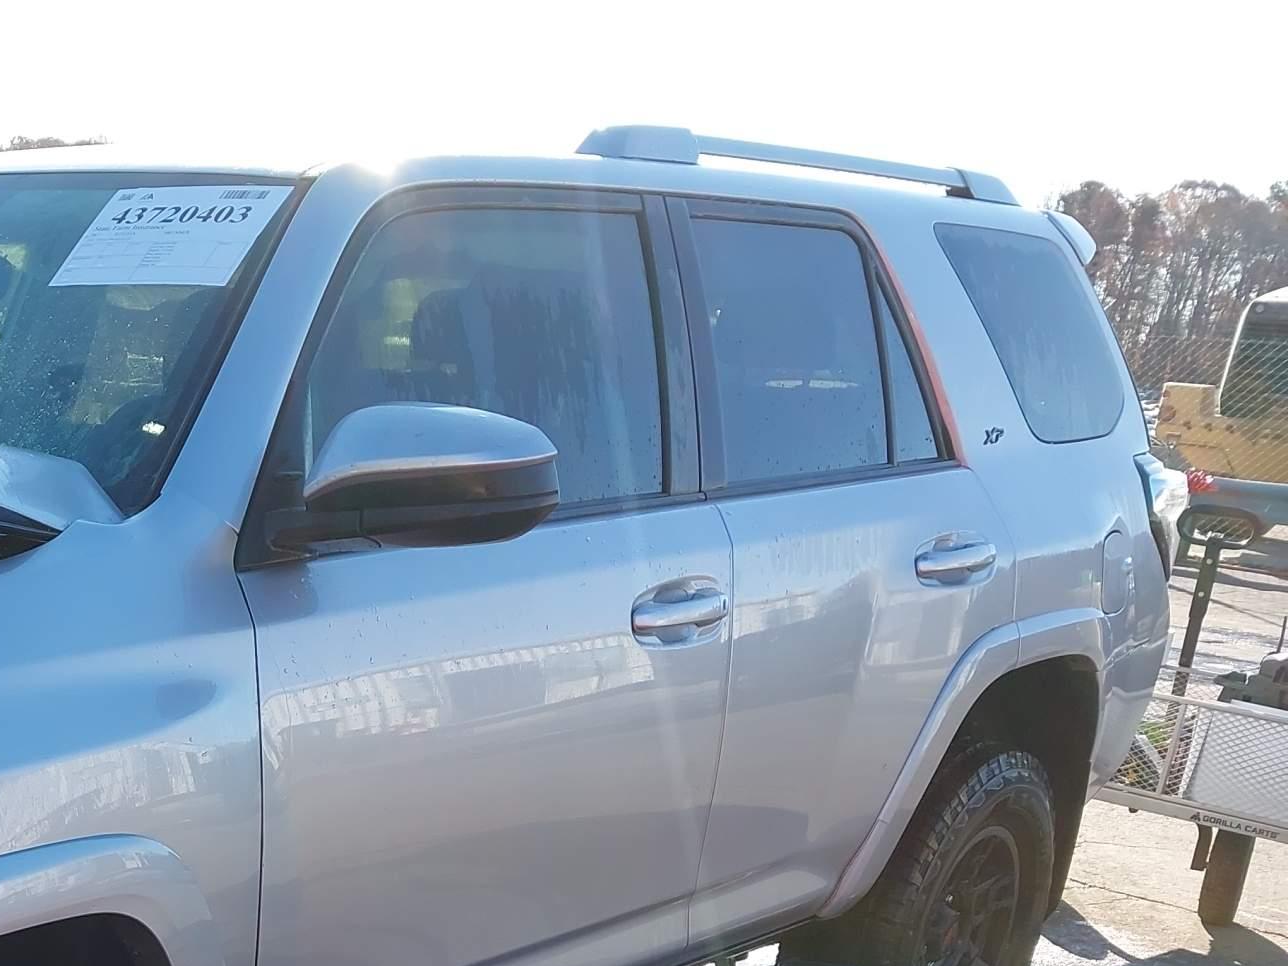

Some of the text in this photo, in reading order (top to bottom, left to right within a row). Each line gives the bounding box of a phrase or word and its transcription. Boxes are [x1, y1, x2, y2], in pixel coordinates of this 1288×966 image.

[111, 206, 253, 225] 43720403
[1202, 815, 1277, 838] GORILLA CARTS
